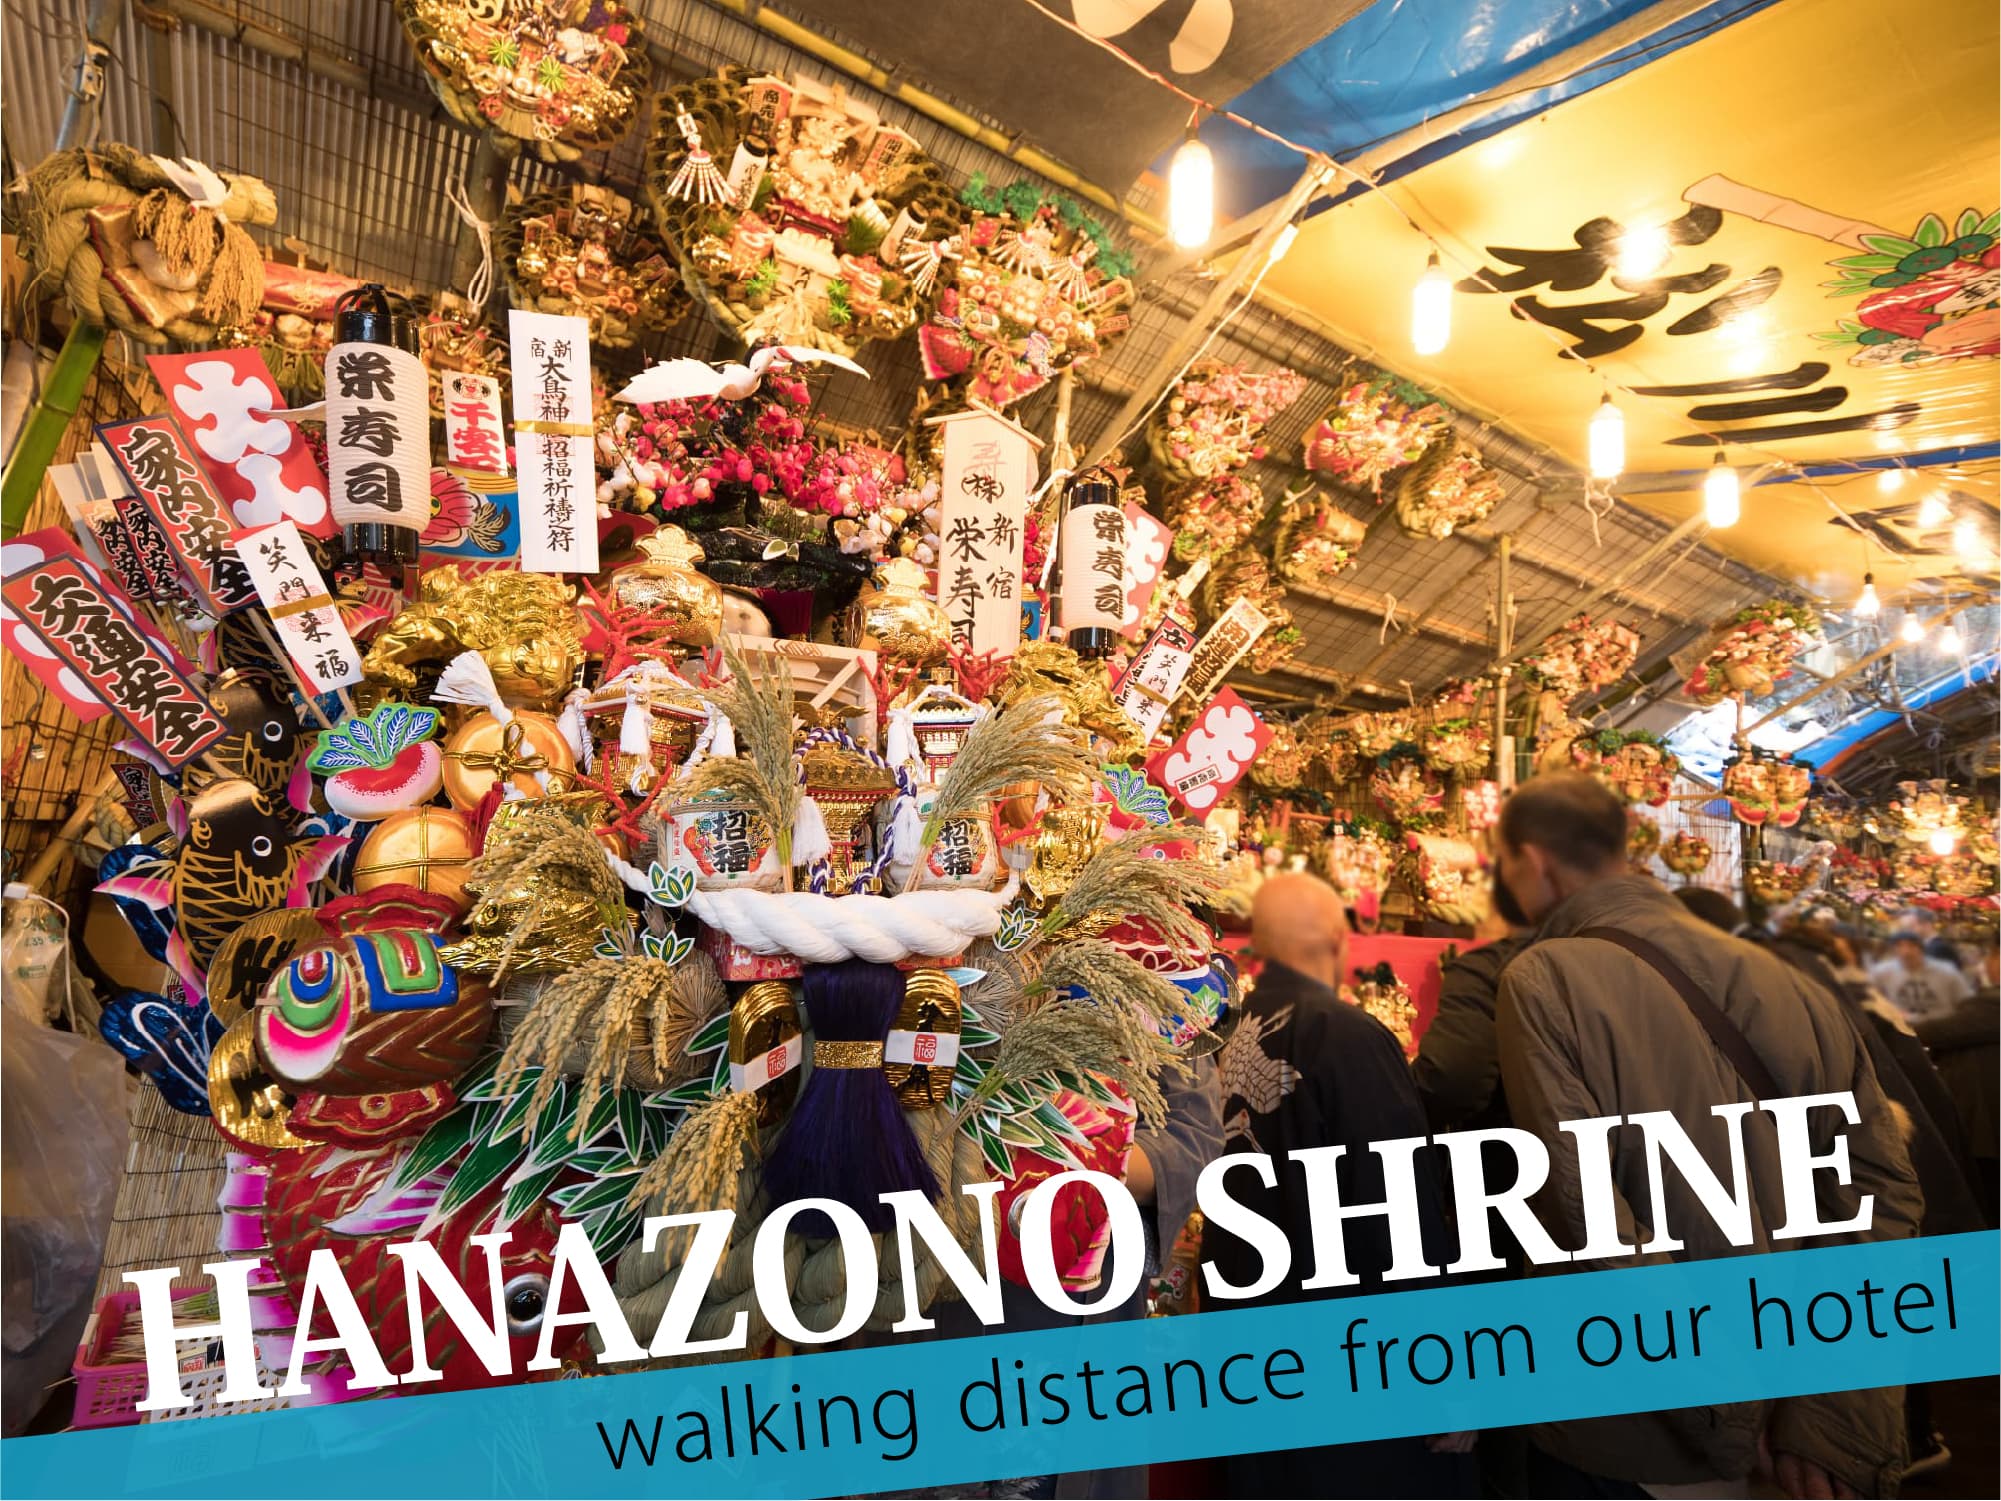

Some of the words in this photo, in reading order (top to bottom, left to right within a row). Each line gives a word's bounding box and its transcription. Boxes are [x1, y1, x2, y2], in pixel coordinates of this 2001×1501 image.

[336, 350, 403, 513] 栄寿司
[121, 426, 257, 604] 家内安全
[985, 512, 1019, 600] 新宿
[259, 537, 349, 680] 笑門来福
[943, 516, 987, 652] 栄寿司
[1092, 510, 1125, 621] 栄寿司
[27, 573, 217, 757] 交通安全
[1132, 654, 1178, 728] 笑門来
[712, 810, 750, 873] 招福
[940, 821, 974, 876] 招福
[767, 1046, 787, 1079] 福
[914, 1034, 937, 1062] 福
